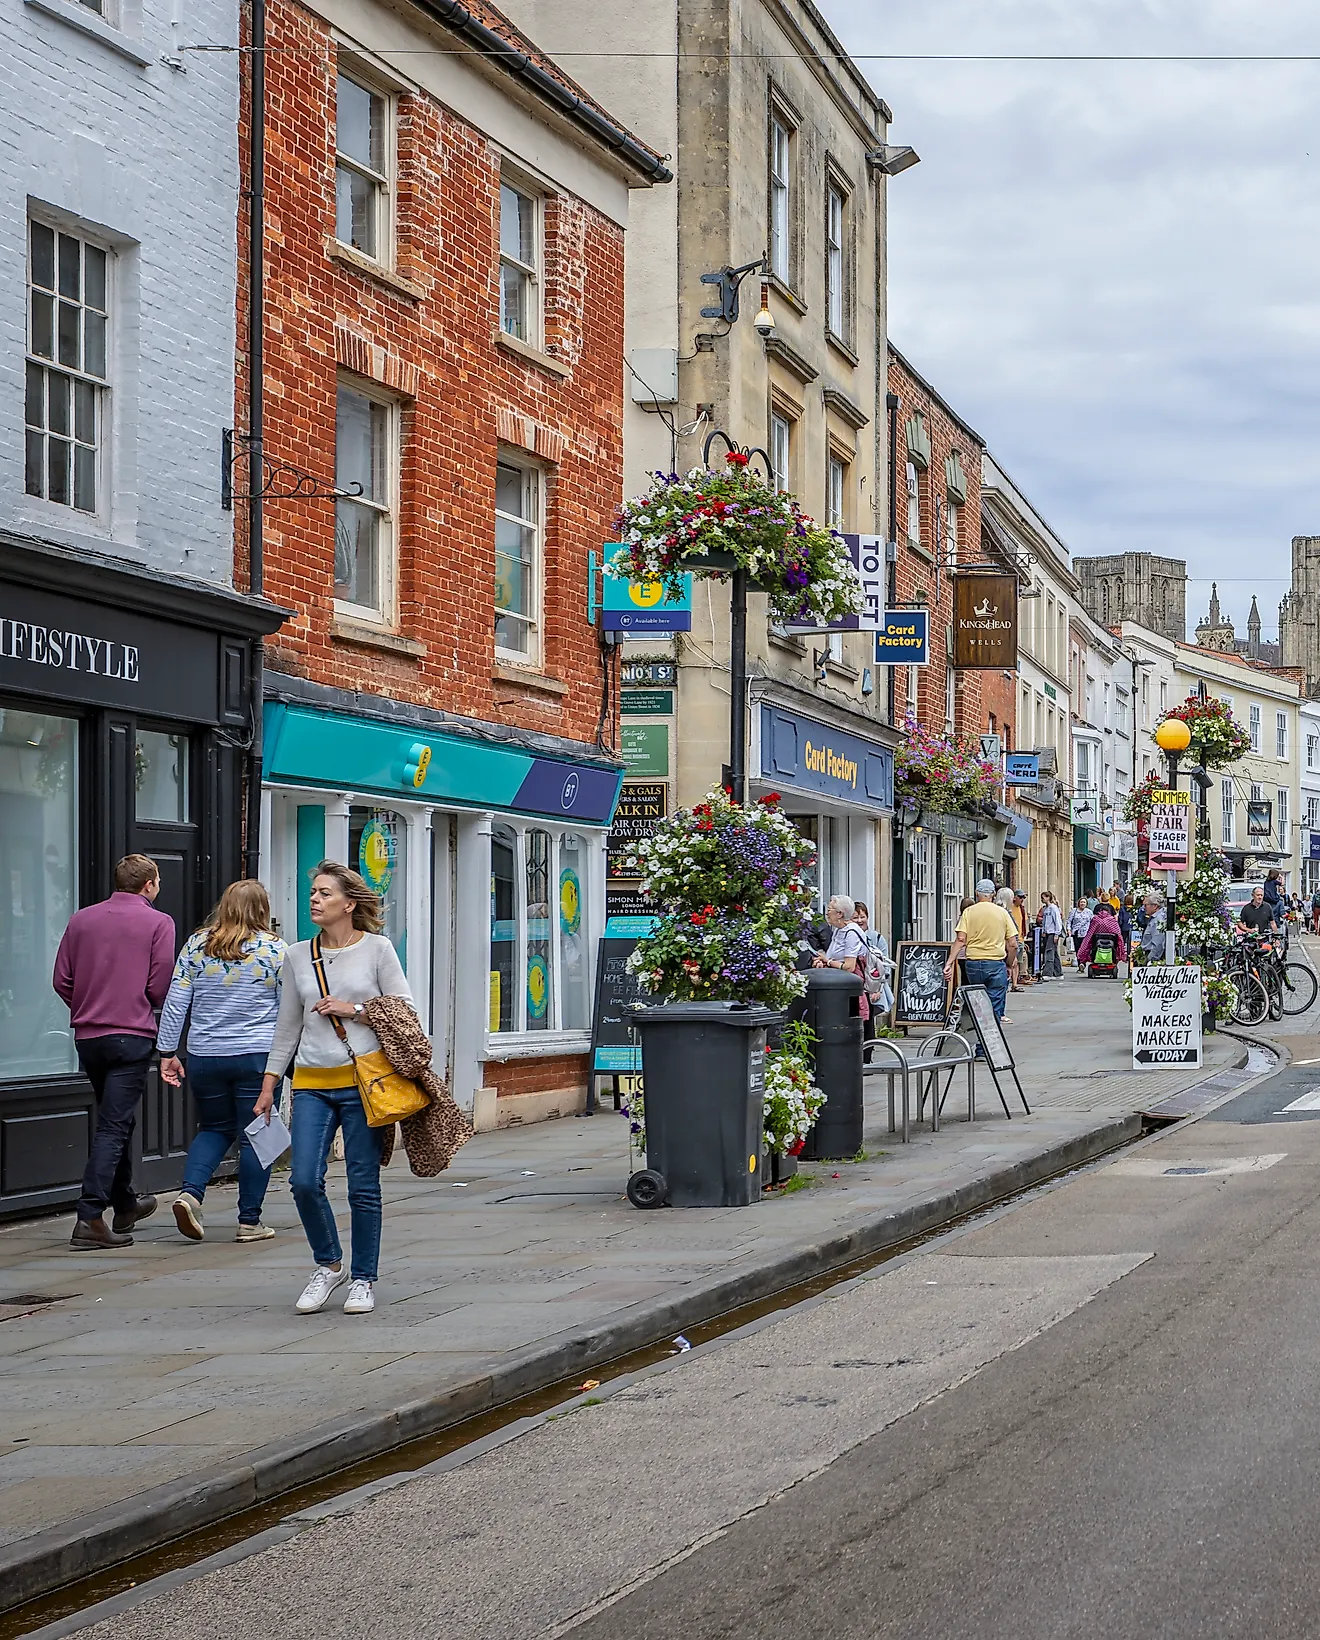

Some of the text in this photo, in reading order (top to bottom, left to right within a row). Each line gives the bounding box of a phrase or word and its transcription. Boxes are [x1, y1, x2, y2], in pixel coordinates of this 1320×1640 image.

[862, 541, 880, 624] TO LET
[887, 625, 915, 635] Card
[879, 636, 923, 648] Factory
[805, 740, 858, 789] Card Factory
[564, 783, 576, 798] BT
[628, 787, 636, 795] &
[637, 787, 662, 795] GALS
[1152, 791, 1188, 804] SUMMER
[644, 804, 660, 816] IN
[1151, 804, 1189, 816] CRAFT
[1156, 817, 1183, 829] FAIR
[1153, 832, 1186, 841] SEAGER
[1157, 842, 1180, 851] HALL
[906, 946, 942, 960] Live
[1134, 967, 1198, 988] Shabby Chic
[1142, 985, 1188, 1003] Vintage
[902, 991, 945, 1013] Music
[1141, 1014, 1193, 1027] MAKERS
[1137, 1030, 1192, 1045] MARKET
[1149, 1049, 1188, 1061] TODAY
